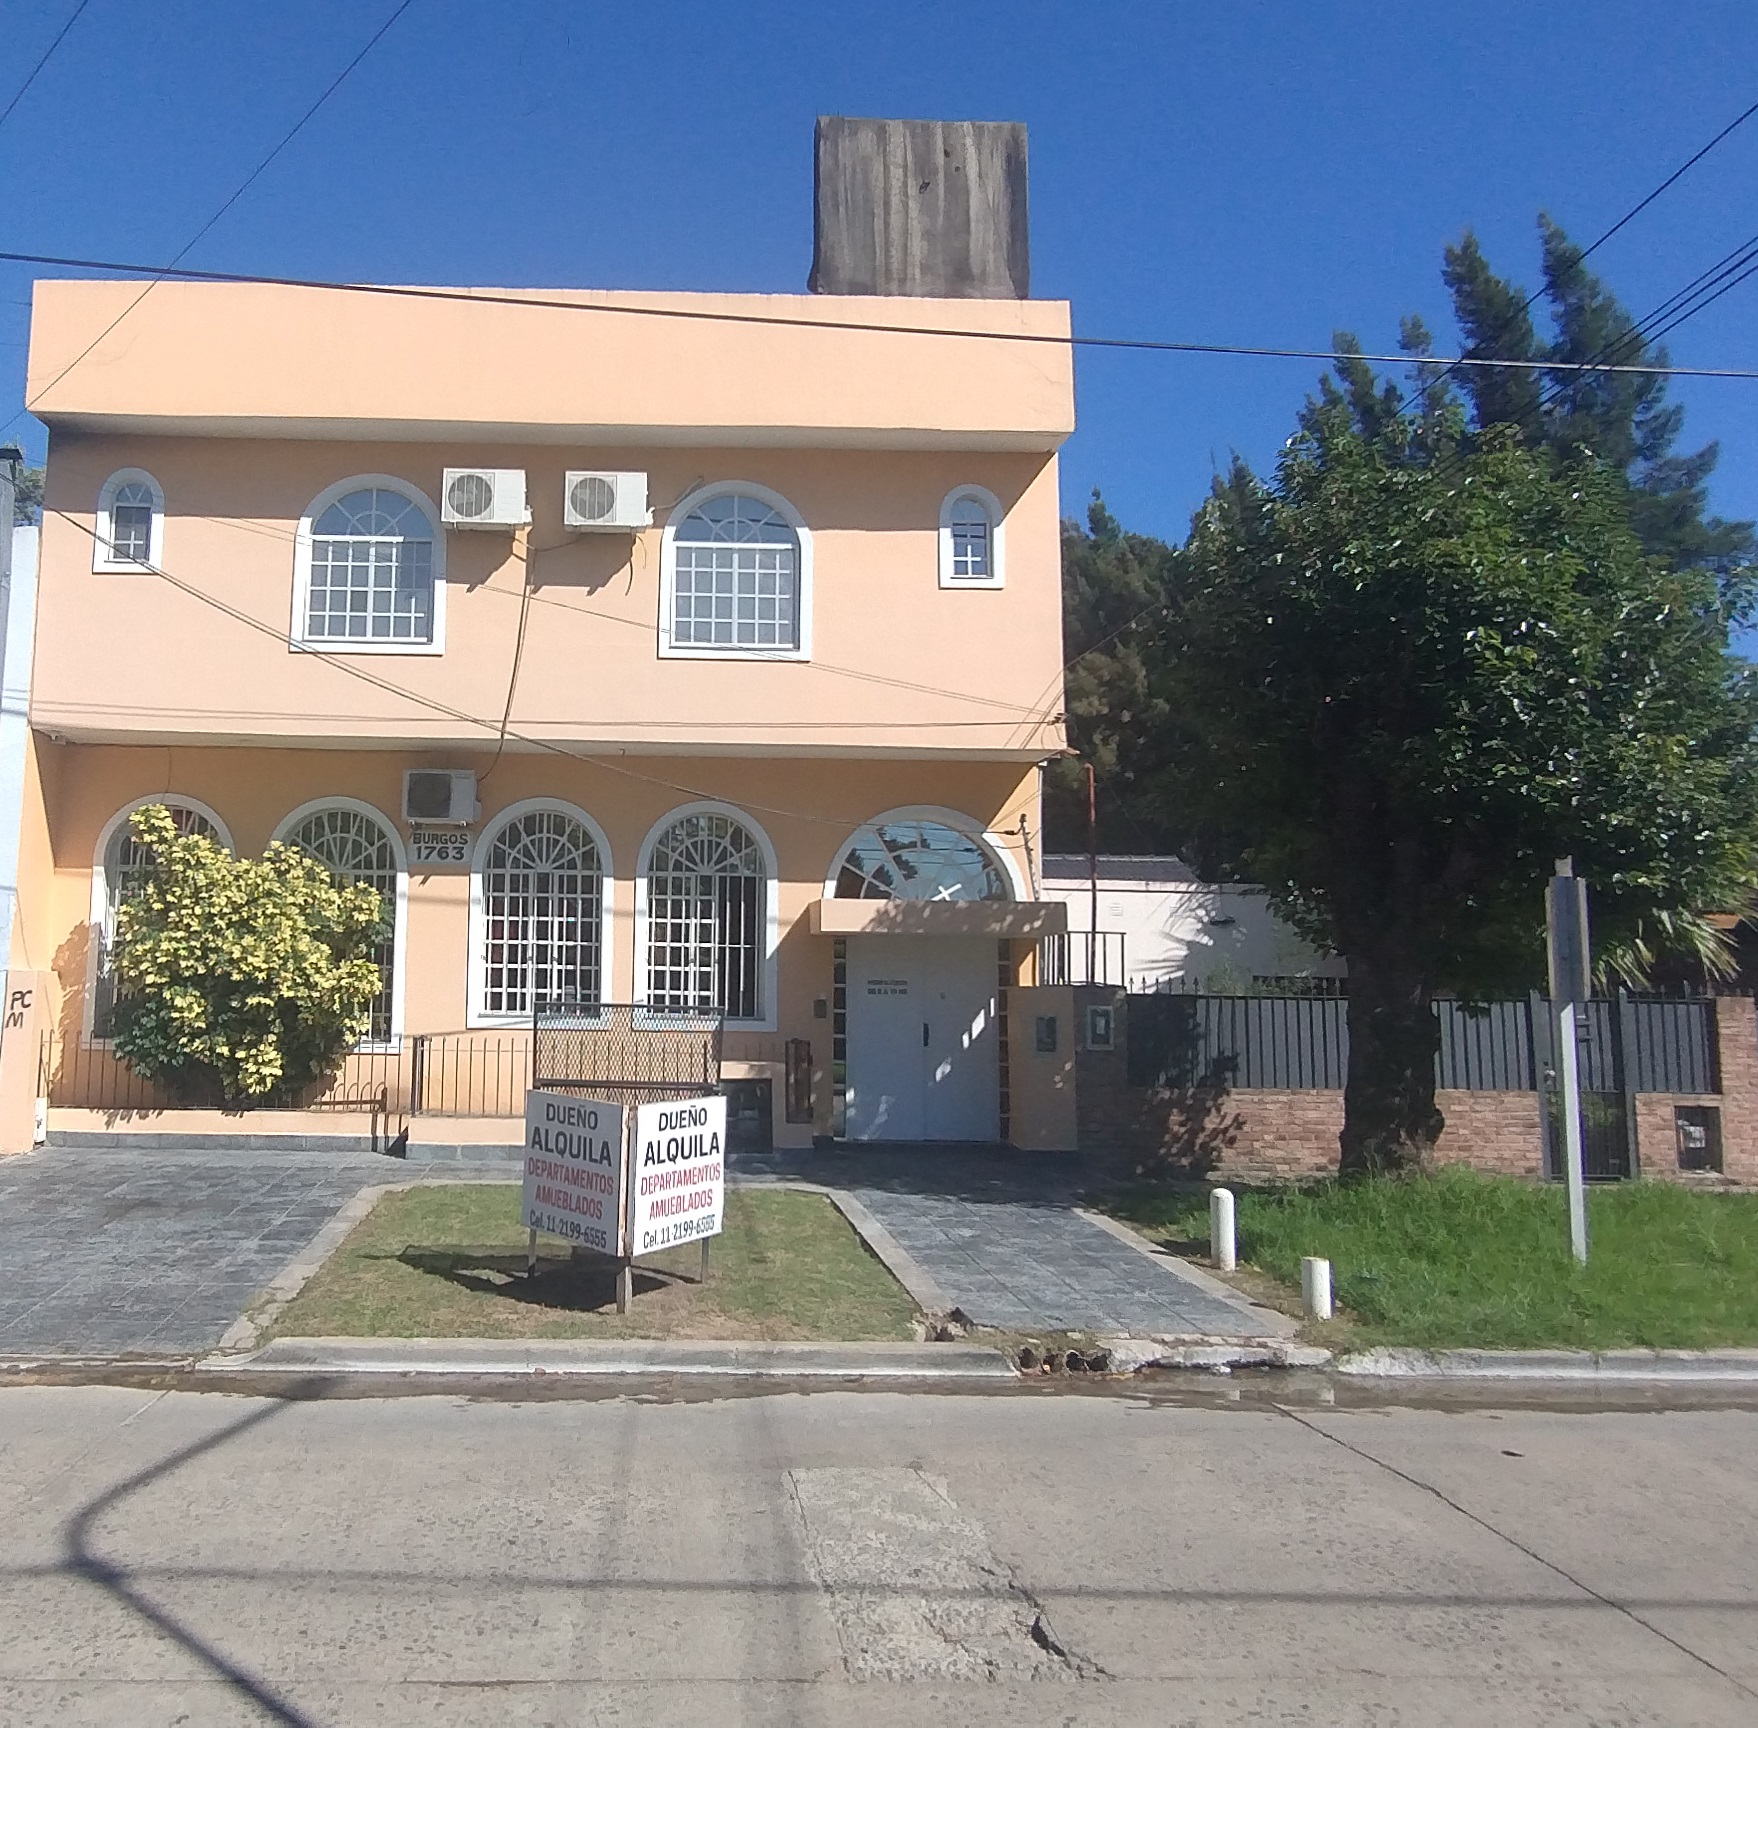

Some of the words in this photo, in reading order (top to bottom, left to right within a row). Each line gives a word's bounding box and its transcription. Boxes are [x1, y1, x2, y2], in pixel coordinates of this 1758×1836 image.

[412, 832, 469, 845] BURGOS
[416, 846, 465, 861] 1763
[10, 989, 33, 1011] PC
[5, 1011, 24, 1029] M
[545, 1102, 598, 1131] DUEÑO
[658, 1104, 708, 1132] DUEÑO
[531, 1125, 613, 1167] ALQUILA
[643, 1131, 720, 1167] ALQUILA
[527, 1156, 614, 1196] DEPARTAMENTOS
[640, 1162, 721, 1196] DEPARTAMENTOS
[535, 1184, 603, 1221] AMUEBLADOS
[649, 1188, 713, 1221] AMUEBLADOS
[529, 1208, 545, 1229] Cel.
[643, 1229, 659, 1249] Cel.
